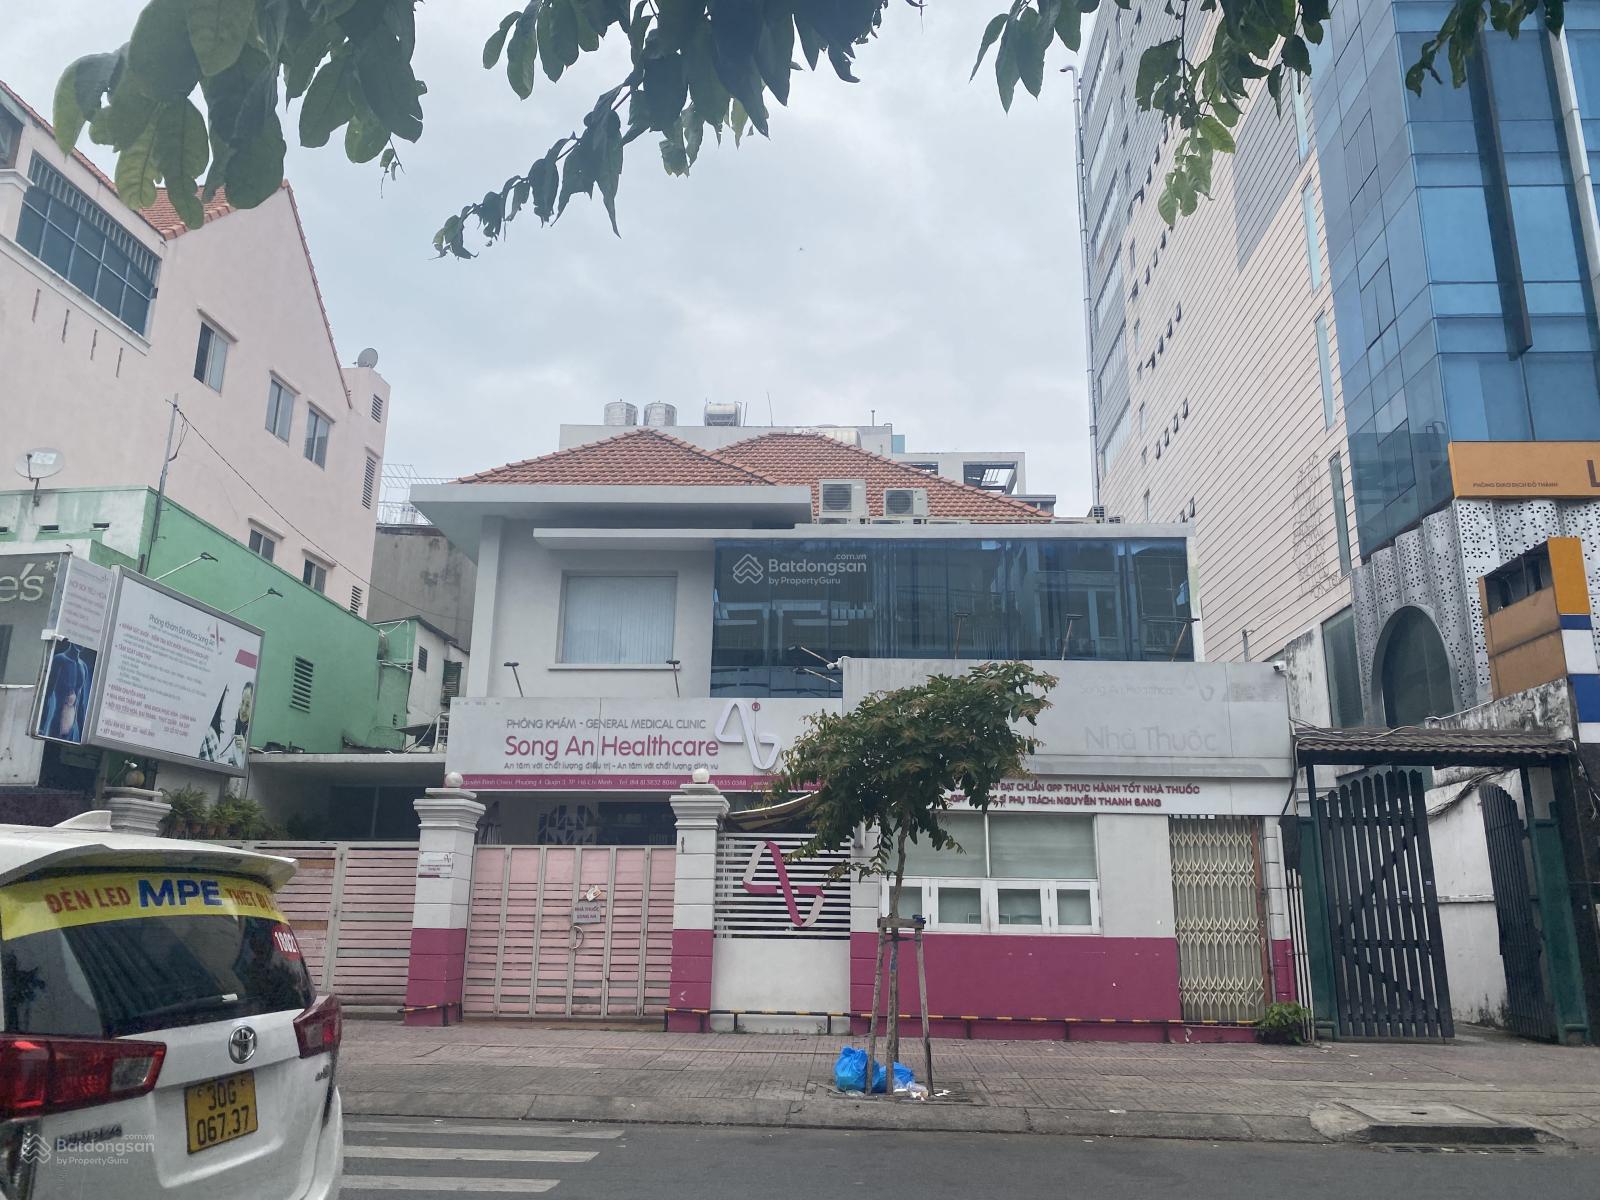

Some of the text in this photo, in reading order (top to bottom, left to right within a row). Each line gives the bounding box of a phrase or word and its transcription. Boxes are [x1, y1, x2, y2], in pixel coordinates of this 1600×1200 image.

[507, 717, 543, 729] PHÒNG
[546, 717, 576, 729] KHÁM
[586, 719, 628, 729] GENERAL
[630, 719, 674, 729] MEDICAL
[676, 719, 706, 729] CLINIC
[505, 734, 719, 761] Song An Healthcare
[1084, 725, 1217, 752] Nhà Thuốc
[545, 761, 560, 769] chất
[1001, 782, 1015, 792] ĐẠT
[1017, 781, 1044, 792] CHUẨN
[1046, 783, 1062, 792] GPP
[1064, 783, 1091, 793] THỰC
[1093, 782, 1120, 793] HÀNH
[1122, 781, 1141, 793] TỐT
[1143, 783, 1164, 794] NHÀ
[1166, 782, 1200, 794] THUỐC
[1009, 795, 1025, 804] PHỤ
[1057, 794, 1096, 806] NGUYỄN
[1098, 797, 1132, 807] THANH
[46, 887, 93, 913] ĐÈN
[94, 886, 131, 908] LED
[138, 879, 223, 907] MPE
[206, 1080, 237, 1111] 30G
[197, 1105, 249, 1145] 067.37
